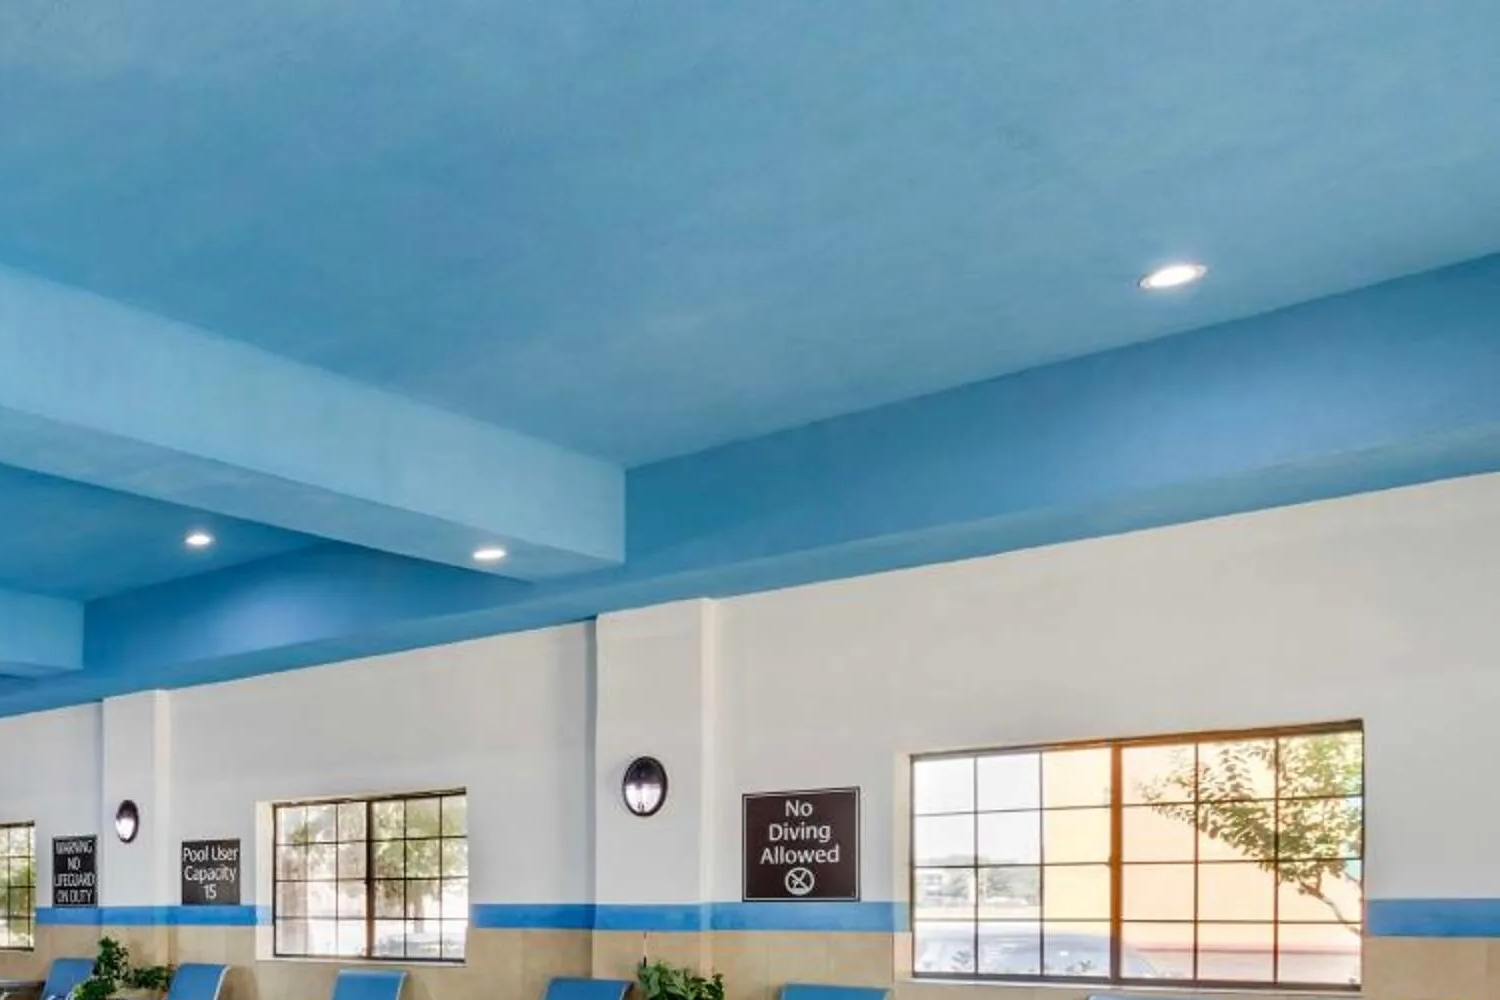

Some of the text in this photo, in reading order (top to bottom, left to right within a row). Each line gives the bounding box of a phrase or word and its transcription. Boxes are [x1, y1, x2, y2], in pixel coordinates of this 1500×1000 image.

[785, 799, 813, 817] No
[769, 821, 832, 844] Diving
[183, 844, 238, 862] Pool User
[759, 843, 841, 865] Allowed
[67, 856, 80, 870] NO
[55, 872, 95, 887] LIFEGUARD
[184, 864, 237, 884] Capacity
[202, 883, 217, 899] 15
